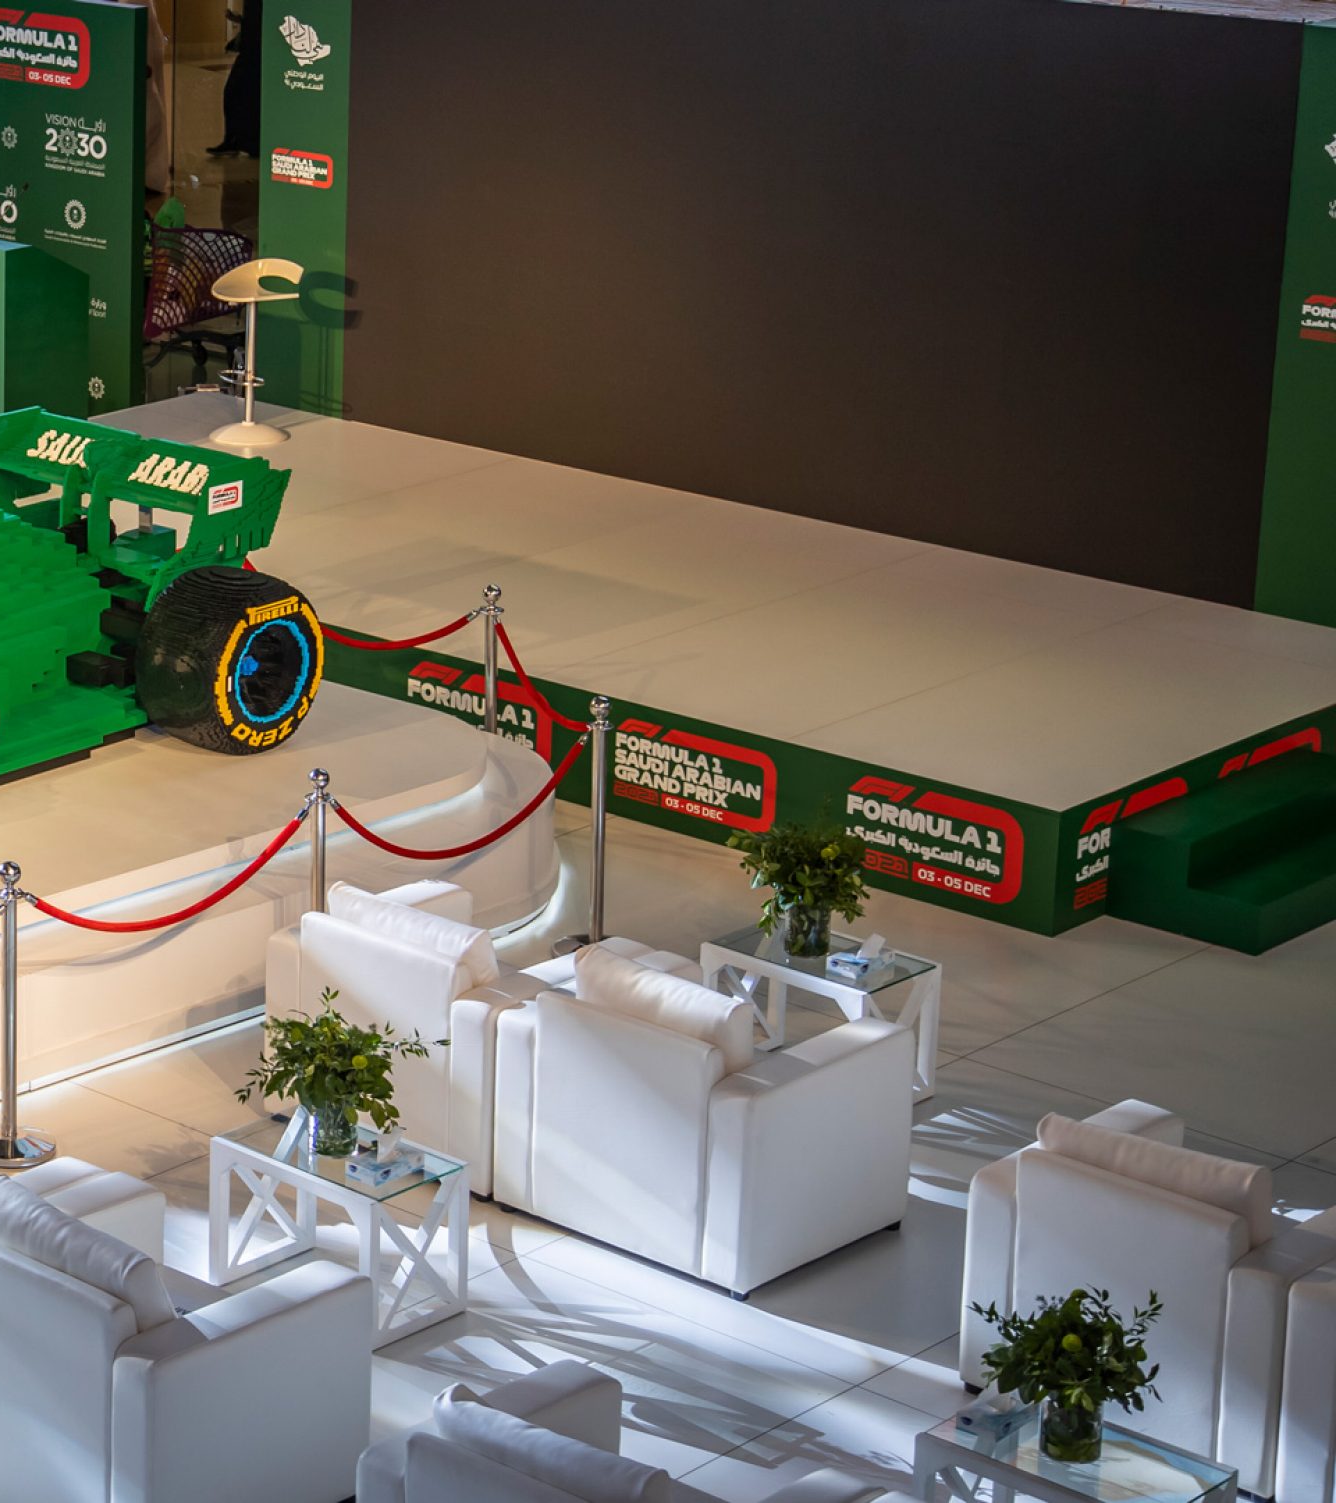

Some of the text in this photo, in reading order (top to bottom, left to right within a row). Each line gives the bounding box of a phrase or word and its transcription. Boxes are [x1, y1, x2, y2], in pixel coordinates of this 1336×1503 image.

[68, 35, 78, 51] 1
[55, 74, 72, 86] DEC
[45, 113, 77, 128] VISION
[26, 430, 94, 469] SAU
[246, 596, 299, 627] PIRELLI
[407, 678, 535, 729] FORMUA 1
[231, 716, 295, 747] ZERO
[615, 732, 723, 774] FORMULA 1
[614, 765, 728, 808] GRAND PRIX
[615, 749, 761, 800] SAUDI ARABIAN
[665, 797, 680, 808] 03
[686, 803, 700, 814] 05
[702, 807, 723, 821] DEC
[846, 794, 1002, 853] FORMULA 1
[846, 825, 1000, 877] جائزة السعودية الكبرى
[917, 868, 935, 882] 03
[944, 875, 961, 890] 05
[964, 882, 991, 898] DEC
